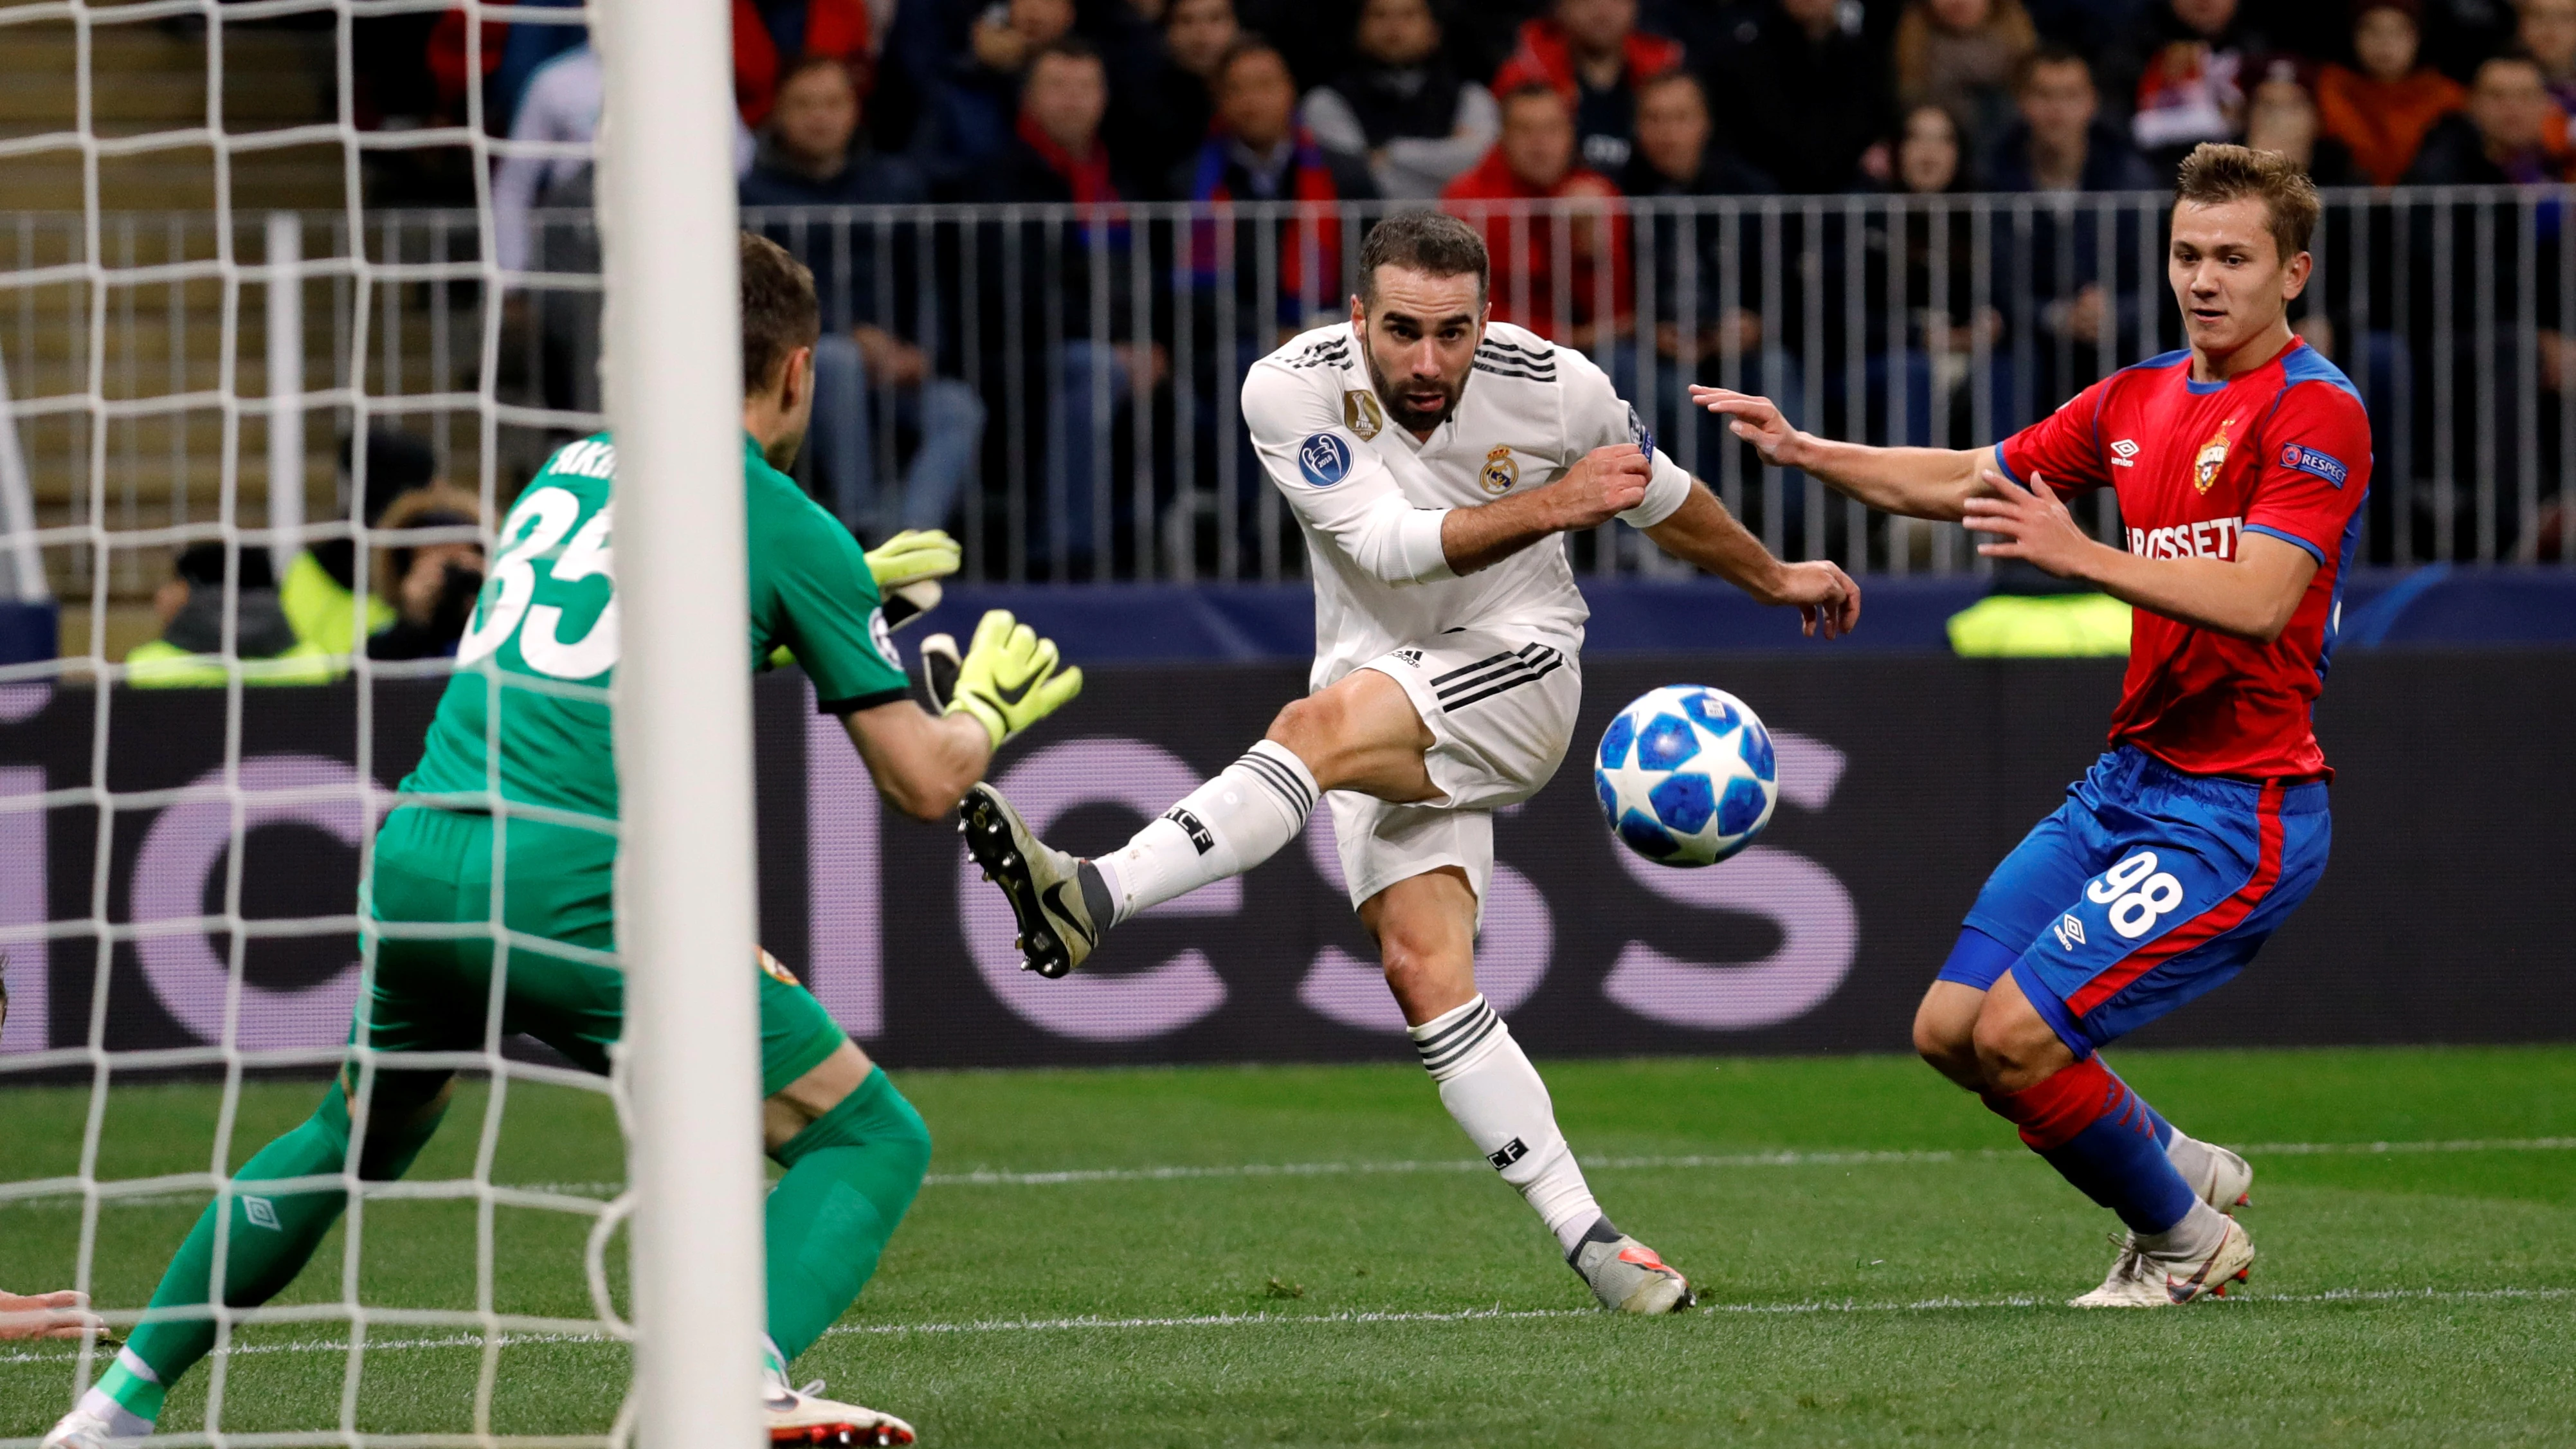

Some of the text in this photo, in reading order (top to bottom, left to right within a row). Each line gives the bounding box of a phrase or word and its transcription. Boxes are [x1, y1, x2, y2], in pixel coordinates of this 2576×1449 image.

[2111, 457, 2134, 467] umbro
[2302, 454, 2346, 482] RESPECT
[451, 487, 620, 679] 35
[2087, 852, 2183, 938] 98
[2054, 925, 2073, 951] umbro
